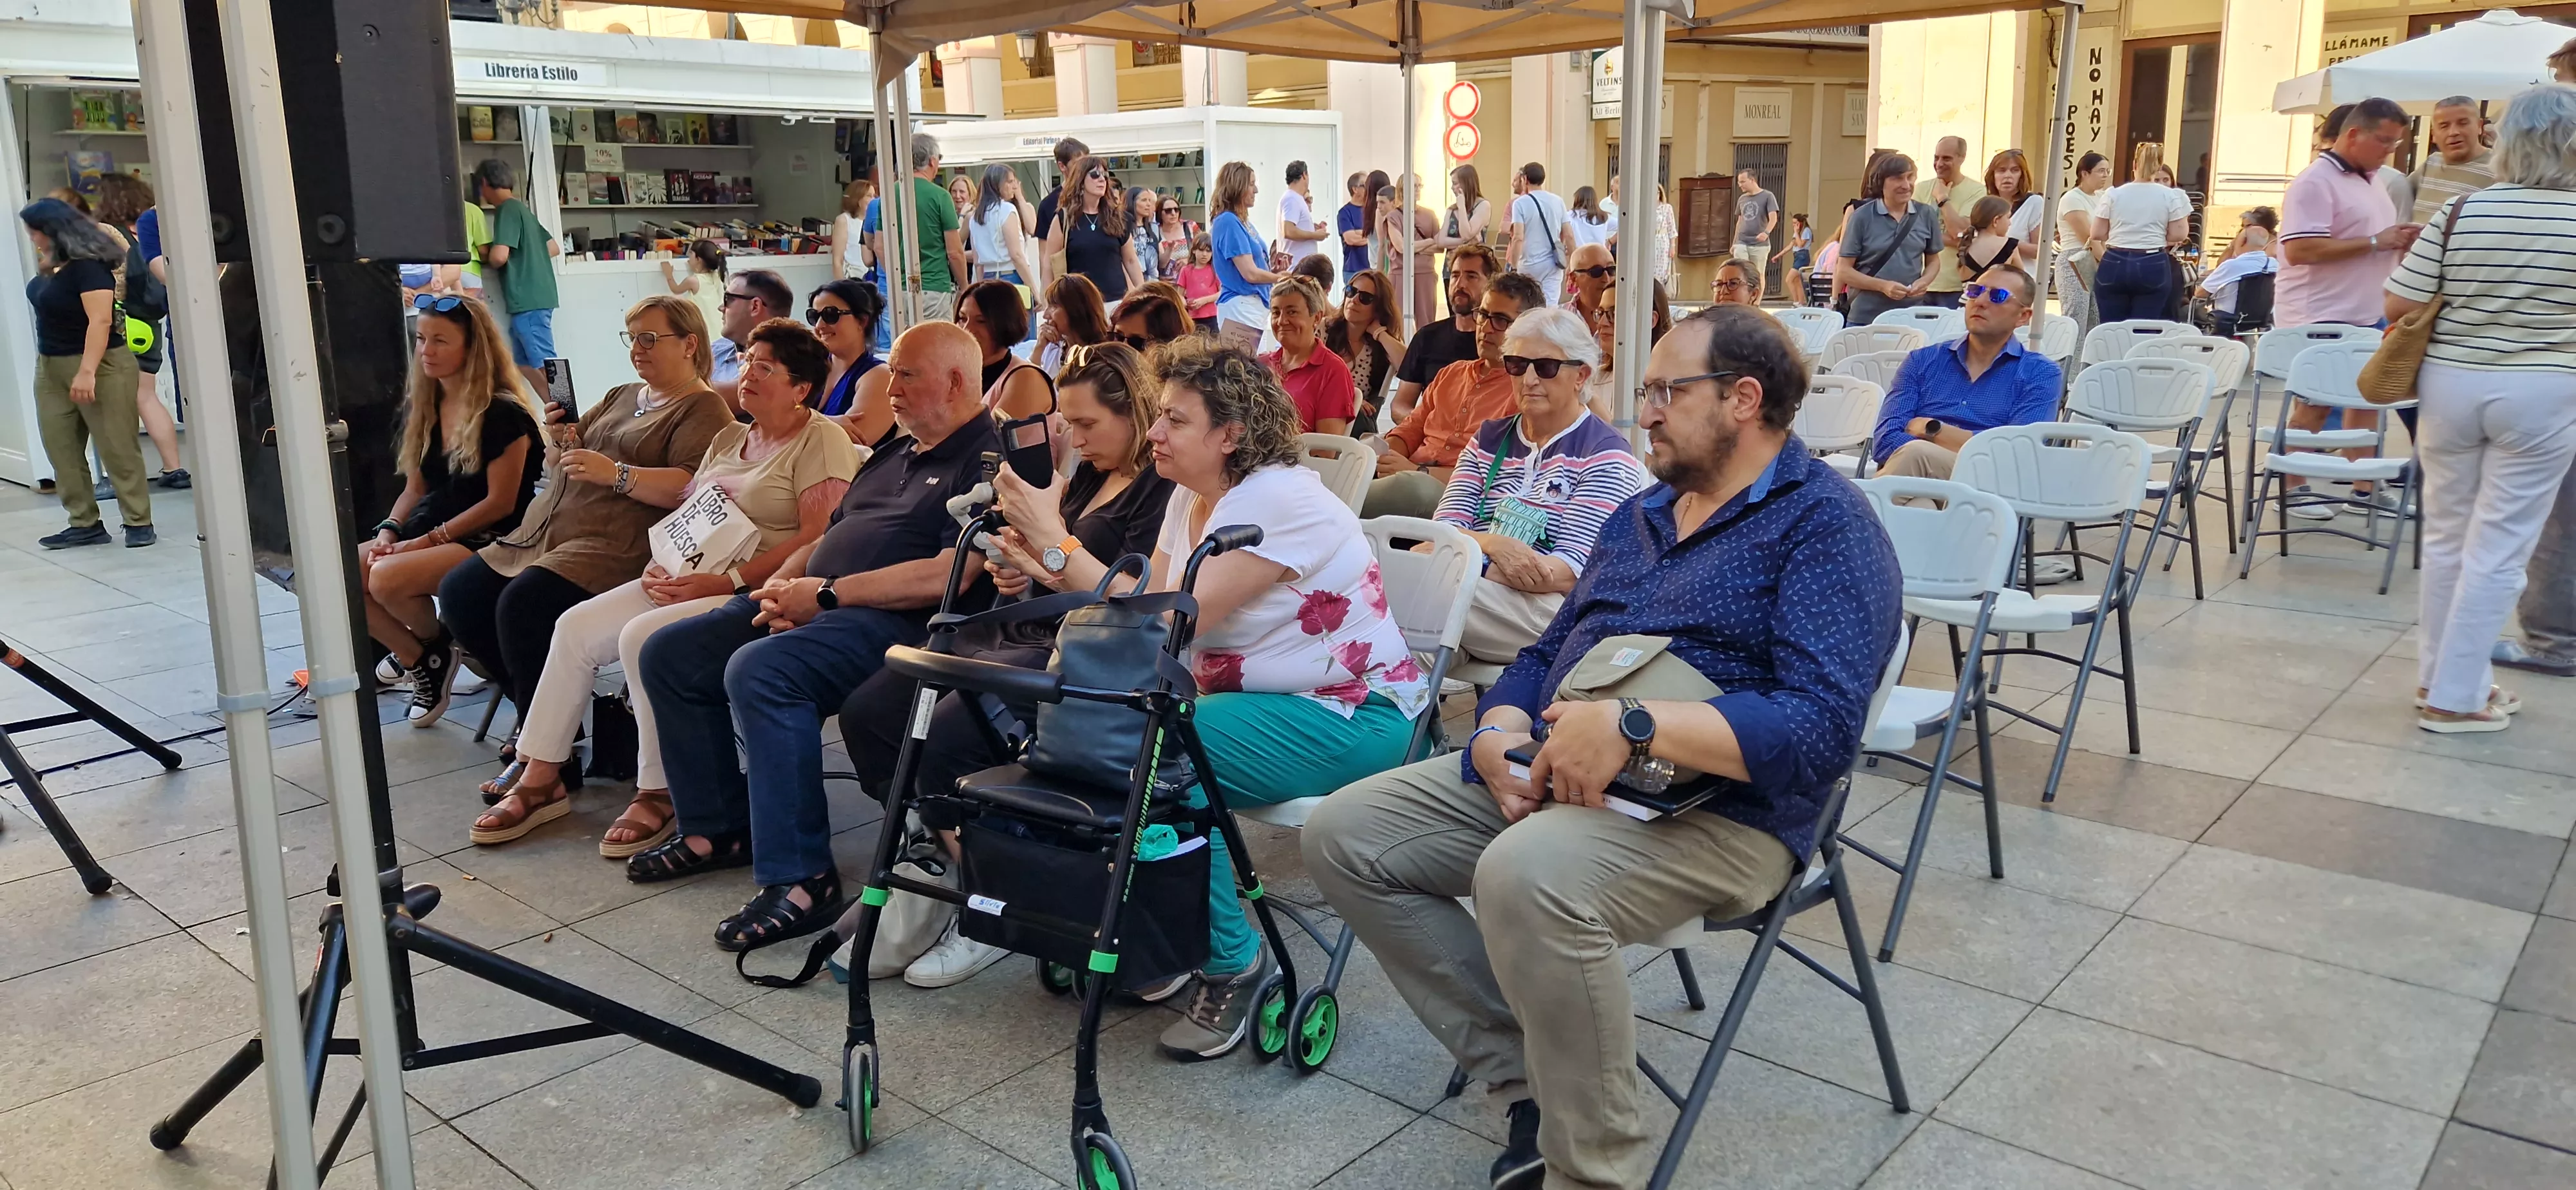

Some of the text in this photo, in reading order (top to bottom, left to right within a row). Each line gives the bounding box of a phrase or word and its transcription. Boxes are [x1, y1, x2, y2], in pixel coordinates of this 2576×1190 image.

[2324, 35, 2389, 52] LLÁMAME
[484, 62, 578, 81] Librería Estilo
[1596, 77, 1622, 87] VELTINS
[2089, 47, 2103, 142] NO HAY
[1744, 104, 1781, 119] MONREAL
[1023, 137, 1043, 146] Editorial
[595, 149, 612, 157] 10%
[681, 502, 700, 525] DE
[696, 488, 728, 526] LIBRO
[664, 516, 705, 571] HUESCA
